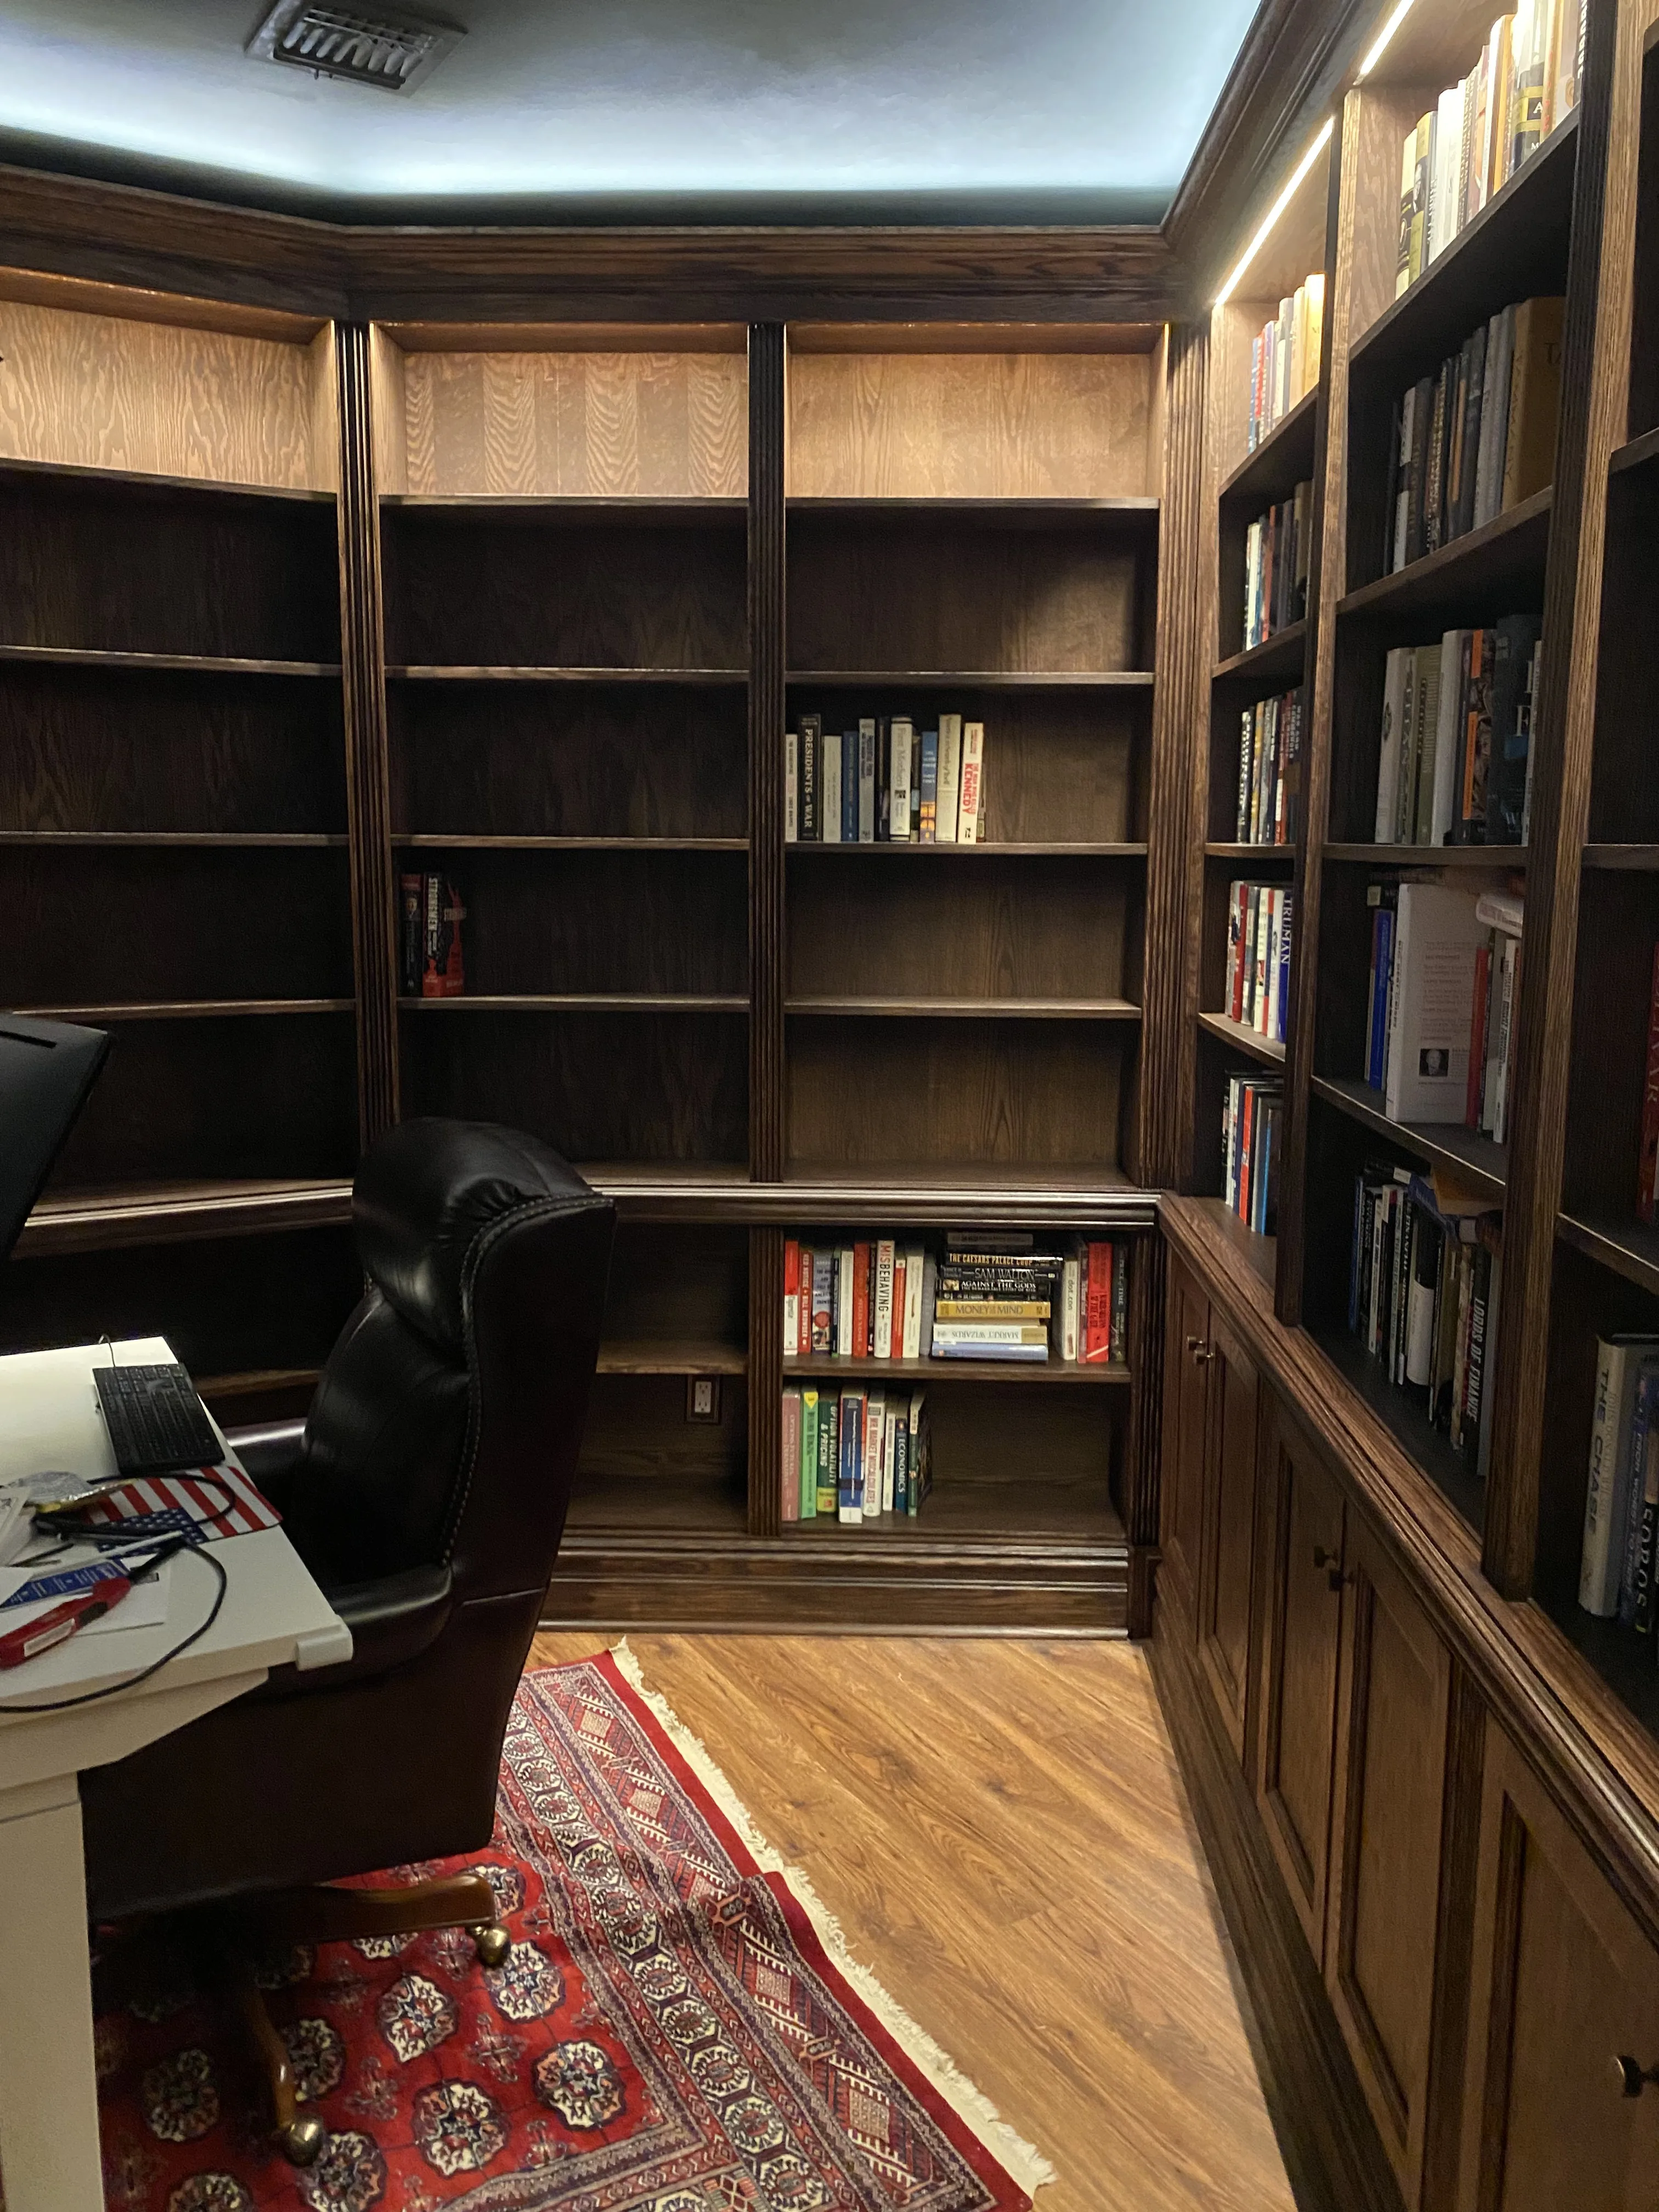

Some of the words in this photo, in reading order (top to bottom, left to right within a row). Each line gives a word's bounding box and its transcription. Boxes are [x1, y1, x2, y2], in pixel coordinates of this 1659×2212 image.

[804, 728, 813, 794] PRESIDENTS
[963, 763, 973, 815] KENNEDY
[878, 1244, 891, 1312] MISBEHAVING
[950, 1254, 961, 1262] THE
[962, 1255, 990, 1263] CAESARS
[992, 1256, 1013, 1266] PALACE
[975, 1268, 995, 1279] SAM
[998, 1269, 1035, 1280] WALTON
[956, 1305, 989, 1314] MONEY
[998, 1306, 1024, 1314] MIND
[1472, 1297, 1485, 1342] LORDS
[1471, 1344, 1482, 1364] OF
[1467, 1364, 1481, 1423] FINANCE
[820, 1433, 829, 1467] PRICING
